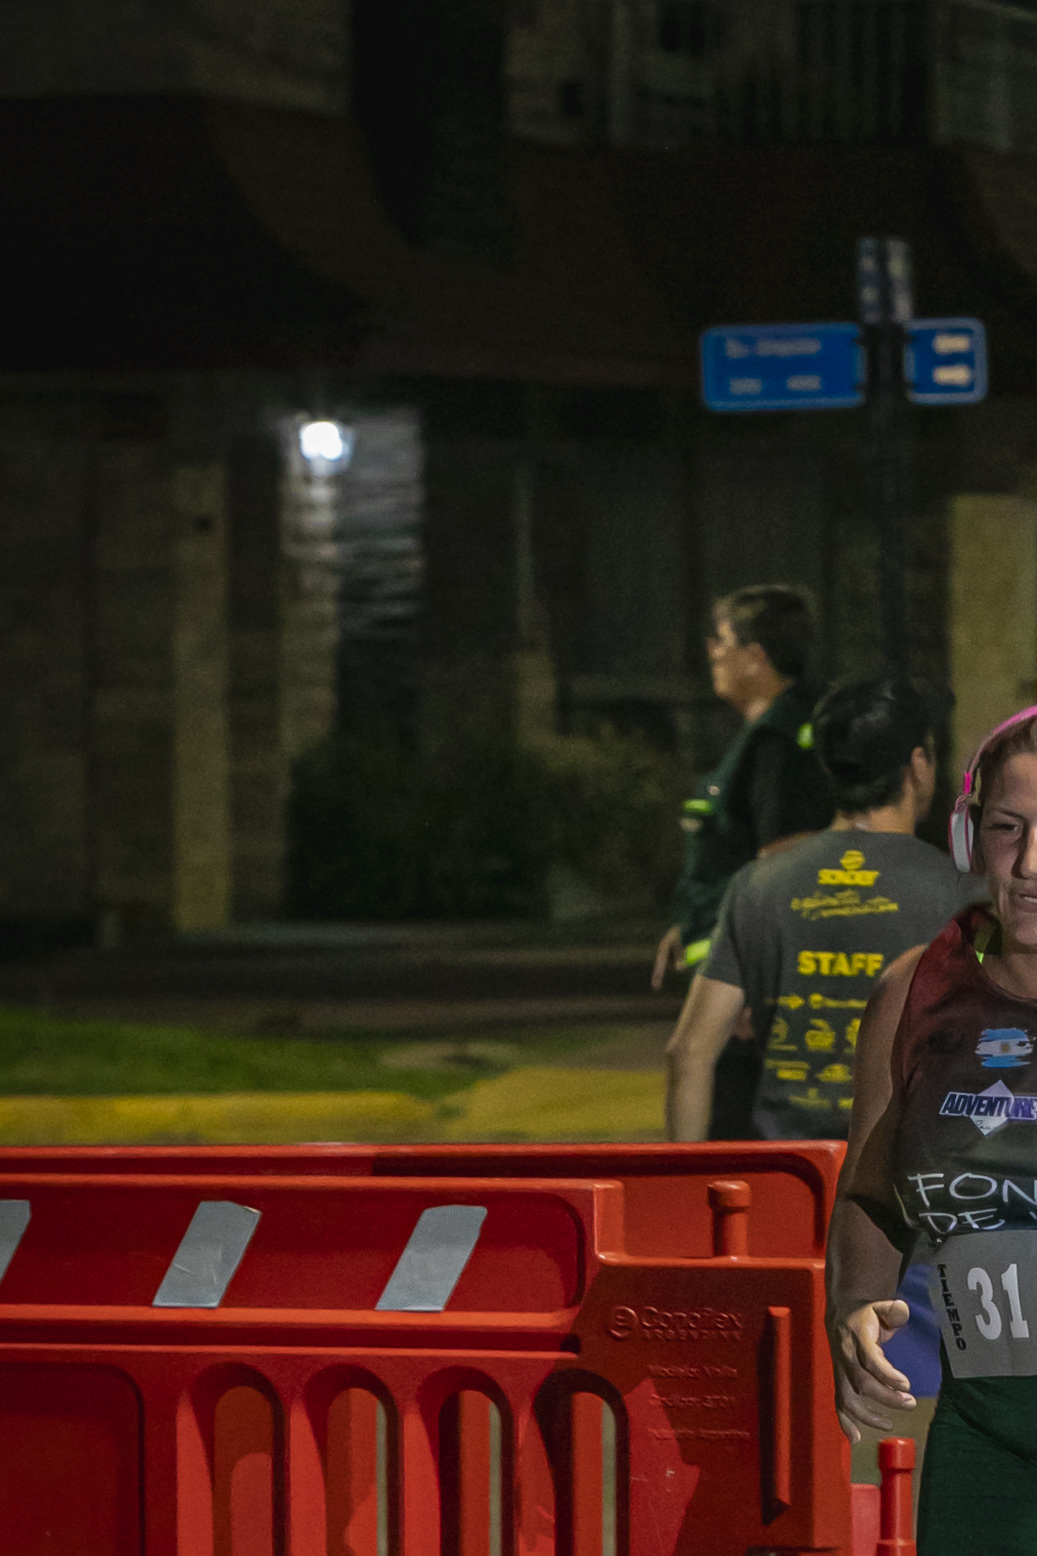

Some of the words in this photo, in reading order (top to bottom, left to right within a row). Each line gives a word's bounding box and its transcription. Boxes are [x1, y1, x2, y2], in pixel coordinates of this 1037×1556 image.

[798, 950, 884, 977] STAFF
[919, 1208, 1005, 1236] DE
[937, 1263, 967, 1351] TIEMPO
[967, 1263, 1030, 1341] 31
